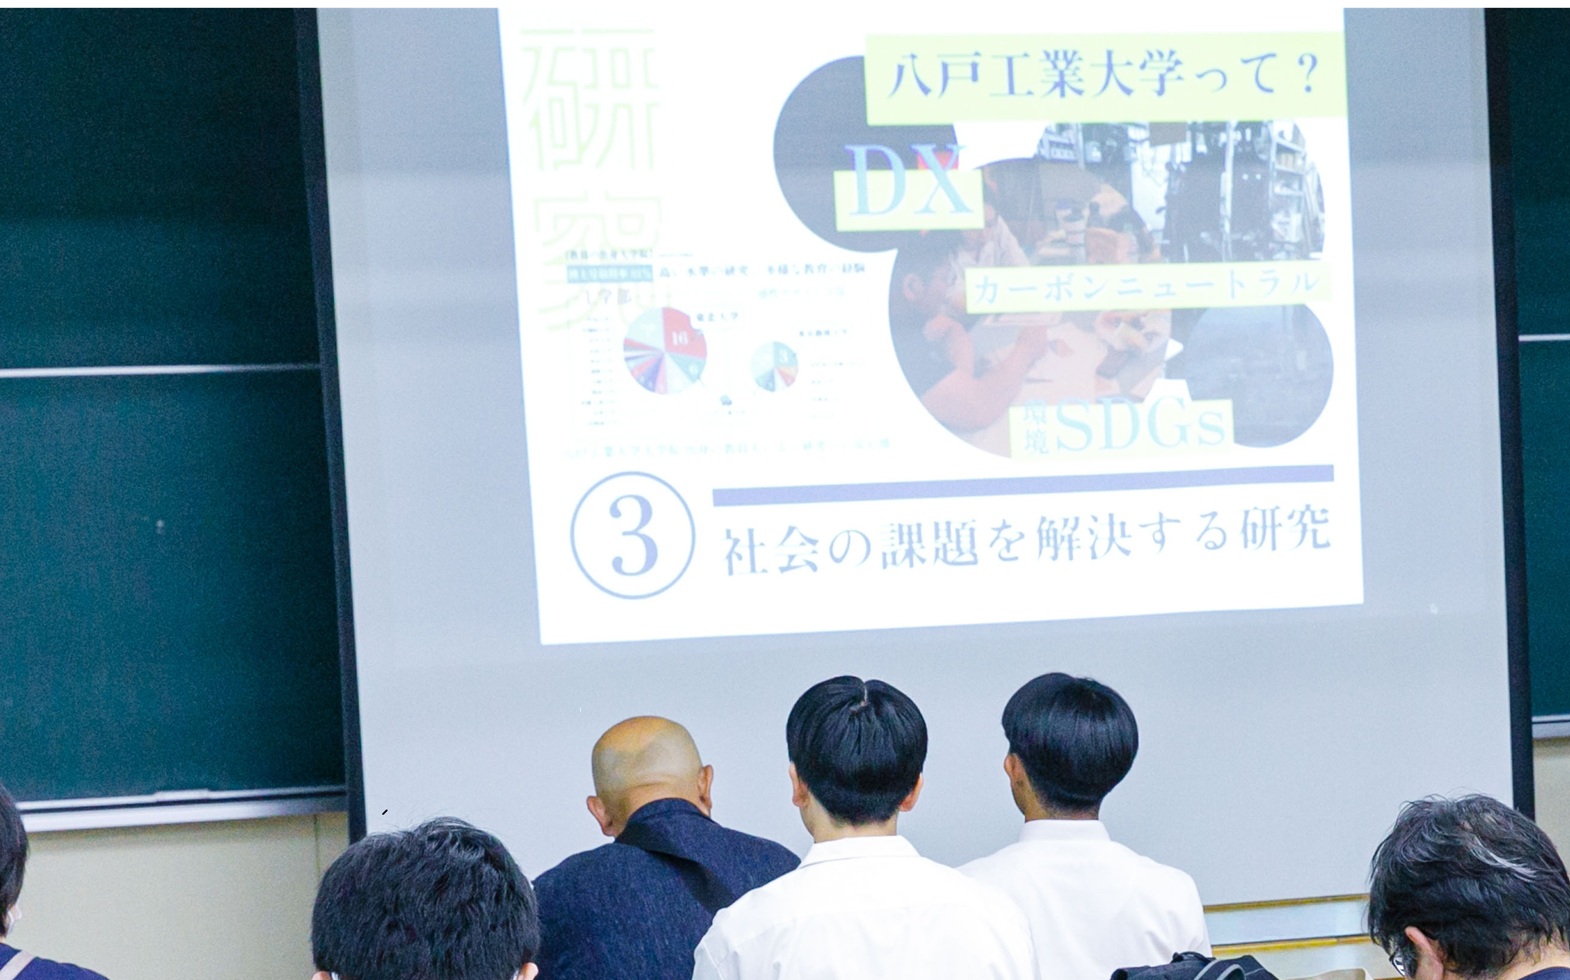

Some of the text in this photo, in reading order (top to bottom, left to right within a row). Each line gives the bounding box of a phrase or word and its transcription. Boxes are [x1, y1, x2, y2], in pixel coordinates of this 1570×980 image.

[888, 48, 1320, 99] 八戸工業大学って？
[844, 143, 974, 216] DX
[974, 268, 1321, 305] カーボンニュートラル
[1022, 400, 1050, 456] 環境
[1055, 396, 1226, 452] SDGs
[721, 503, 1333, 577] 社会の課題を解決する研究
